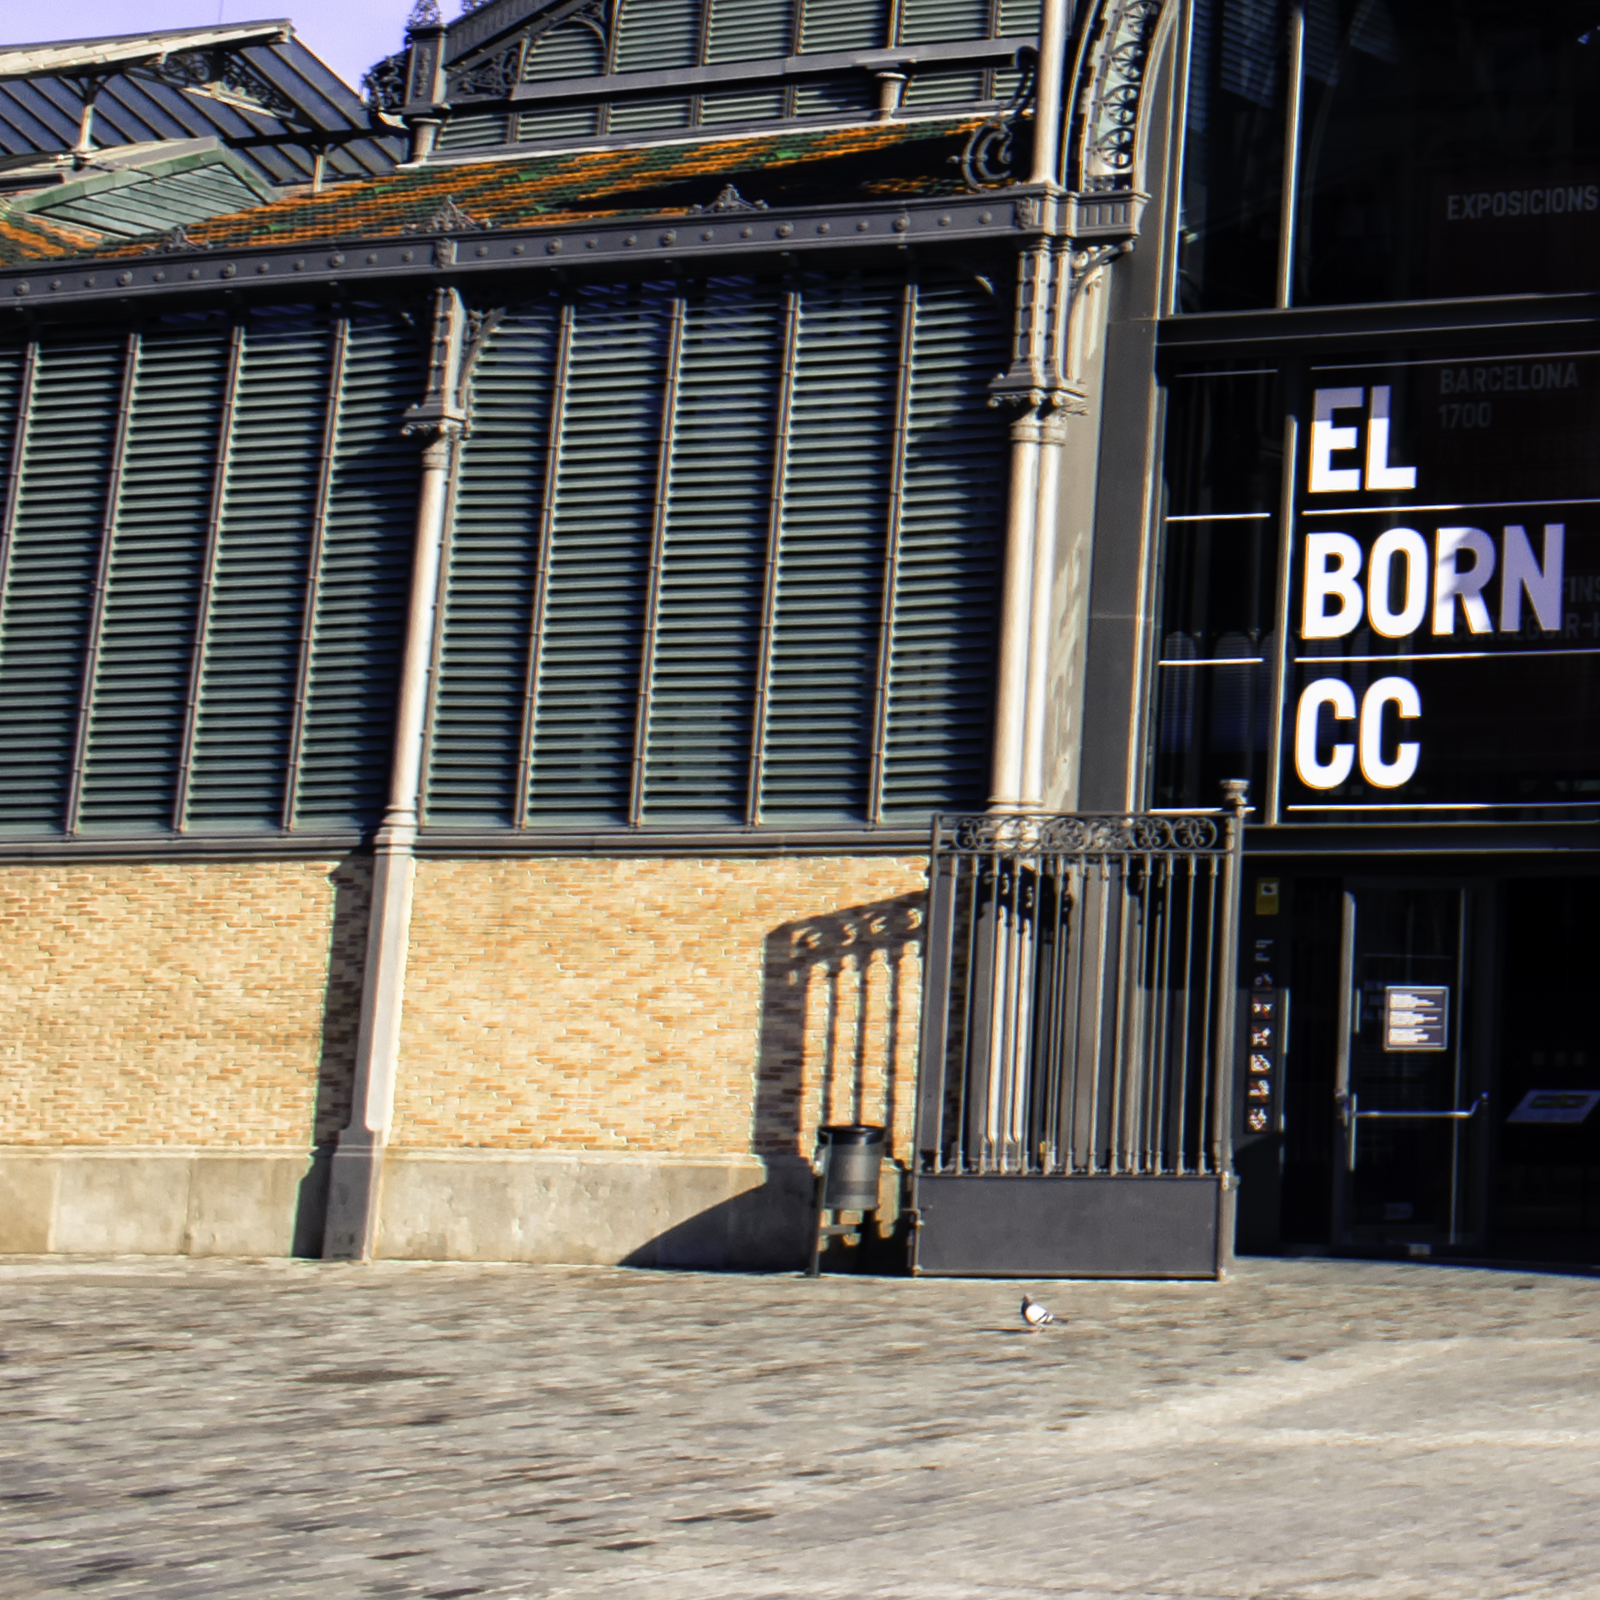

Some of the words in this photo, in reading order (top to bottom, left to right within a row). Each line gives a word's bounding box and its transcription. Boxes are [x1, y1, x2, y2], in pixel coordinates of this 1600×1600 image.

[1447, 185, 1600, 220] EXPOSICIONS
[1439, 361, 1579, 395] BARCELONA
[1308, 385, 1417, 493] EL
[1438, 401, 1492, 430] 1700
[1301, 523, 1565, 640] BORN
[1295, 676, 1421, 789] CC
